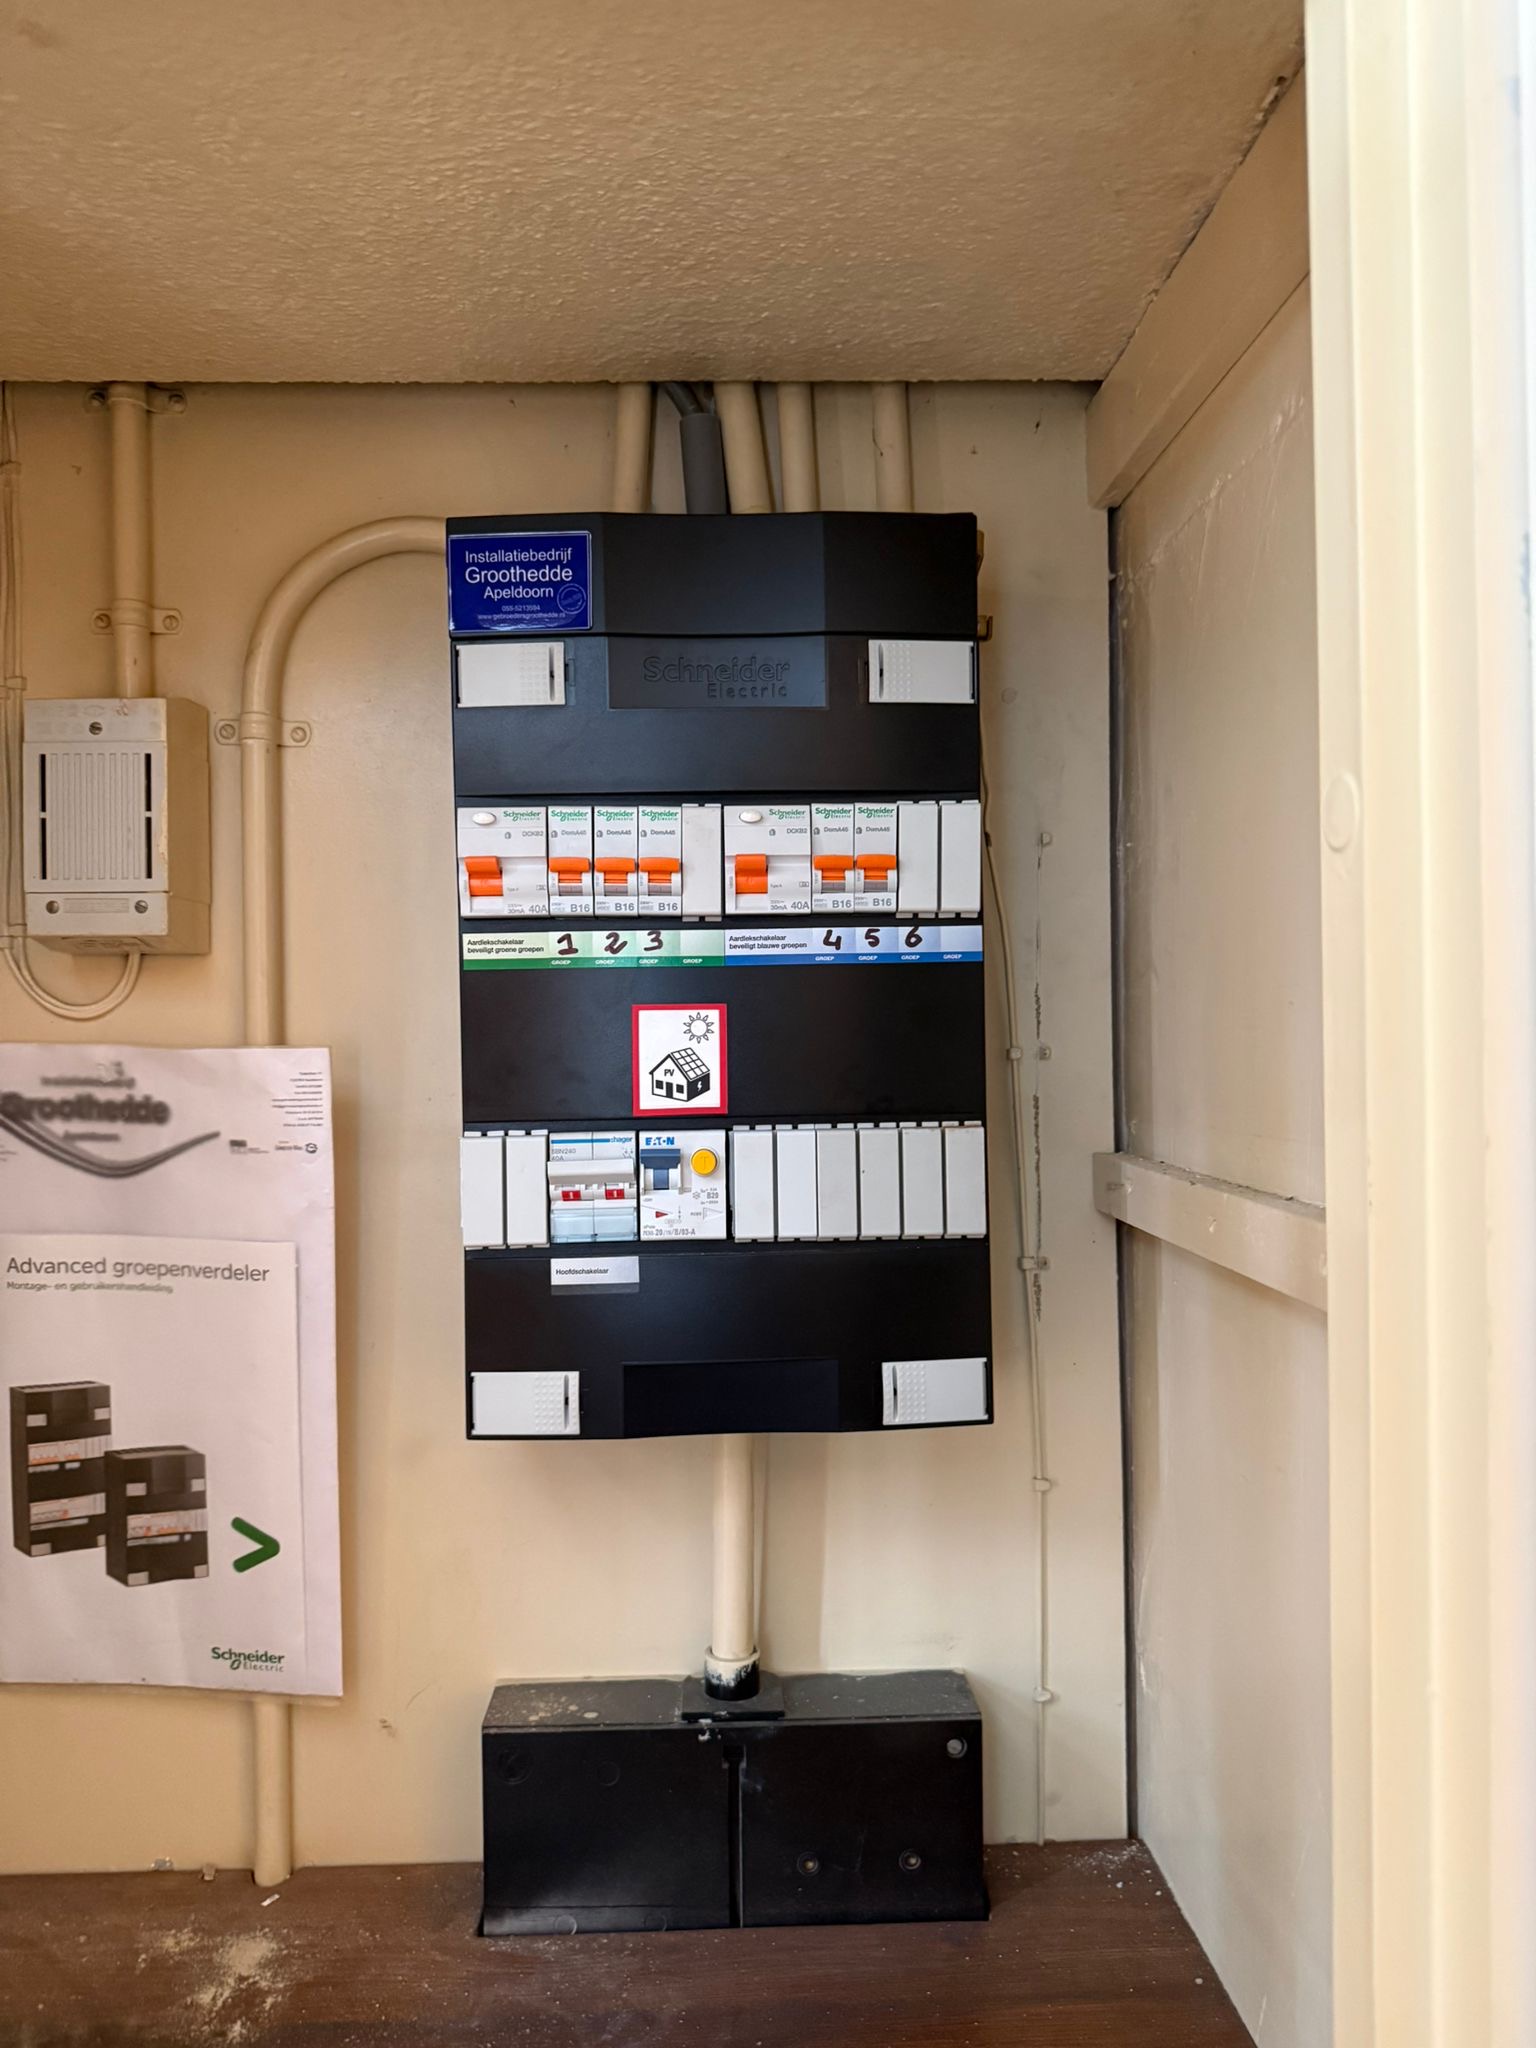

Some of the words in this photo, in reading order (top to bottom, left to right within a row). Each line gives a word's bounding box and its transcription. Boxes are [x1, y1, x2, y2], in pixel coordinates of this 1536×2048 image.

[465, 548, 572, 564] Installatiebedrijf
[465, 565, 572, 583] Groothedde
[483, 586, 553, 601] Apeldoorn
[643, 655, 790, 682] Schneider
[707, 683, 788, 698] Electric
[503, 810, 541, 821] Schneider
[551, 810, 589, 821] Schneider
[597, 810, 635, 821] Schneider
[641, 810, 679, 821] Schneider
[769, 809, 806, 820] Schneider
[815, 807, 852, 818] Schneider
[858, 807, 895, 818] Schneider
[615, 903, 635, 911] B16
[658, 902, 678, 911] B16
[791, 901, 809, 910] 40A
[832, 900, 852, 908] B16
[873, 898, 892, 906] B16
[529, 904, 548, 913] 40A
[570, 904, 590, 912] B16
[467, 938, 524, 946] Aardlekschakelaar
[644, 930, 664, 951] 3
[823, 929, 841, 950] 4
[864, 928, 880, 948] 5
[905, 926, 922, 948] 6
[557, 933, 579, 955] 1
[604, 932, 627, 955] 2
[729, 942, 755, 950] beveiligt
[468, 946, 494, 954] beveiligt
[664, 1069, 675, 1077] PV
[613, 1136, 633, 1144] hager
[645, 1136, 675, 1146] EATON
[7, 1257, 106, 1275] Advanced
[113, 1260, 270, 1282] groepenverdeler
[555, 1267, 609, 1275] Hoofdschakelaar
[7, 1281, 52, 1291] Montage-
[54, 1282, 67, 1290] en
[211, 1646, 285, 1669] Schneider
[242, 1663, 284, 1672] Electric
